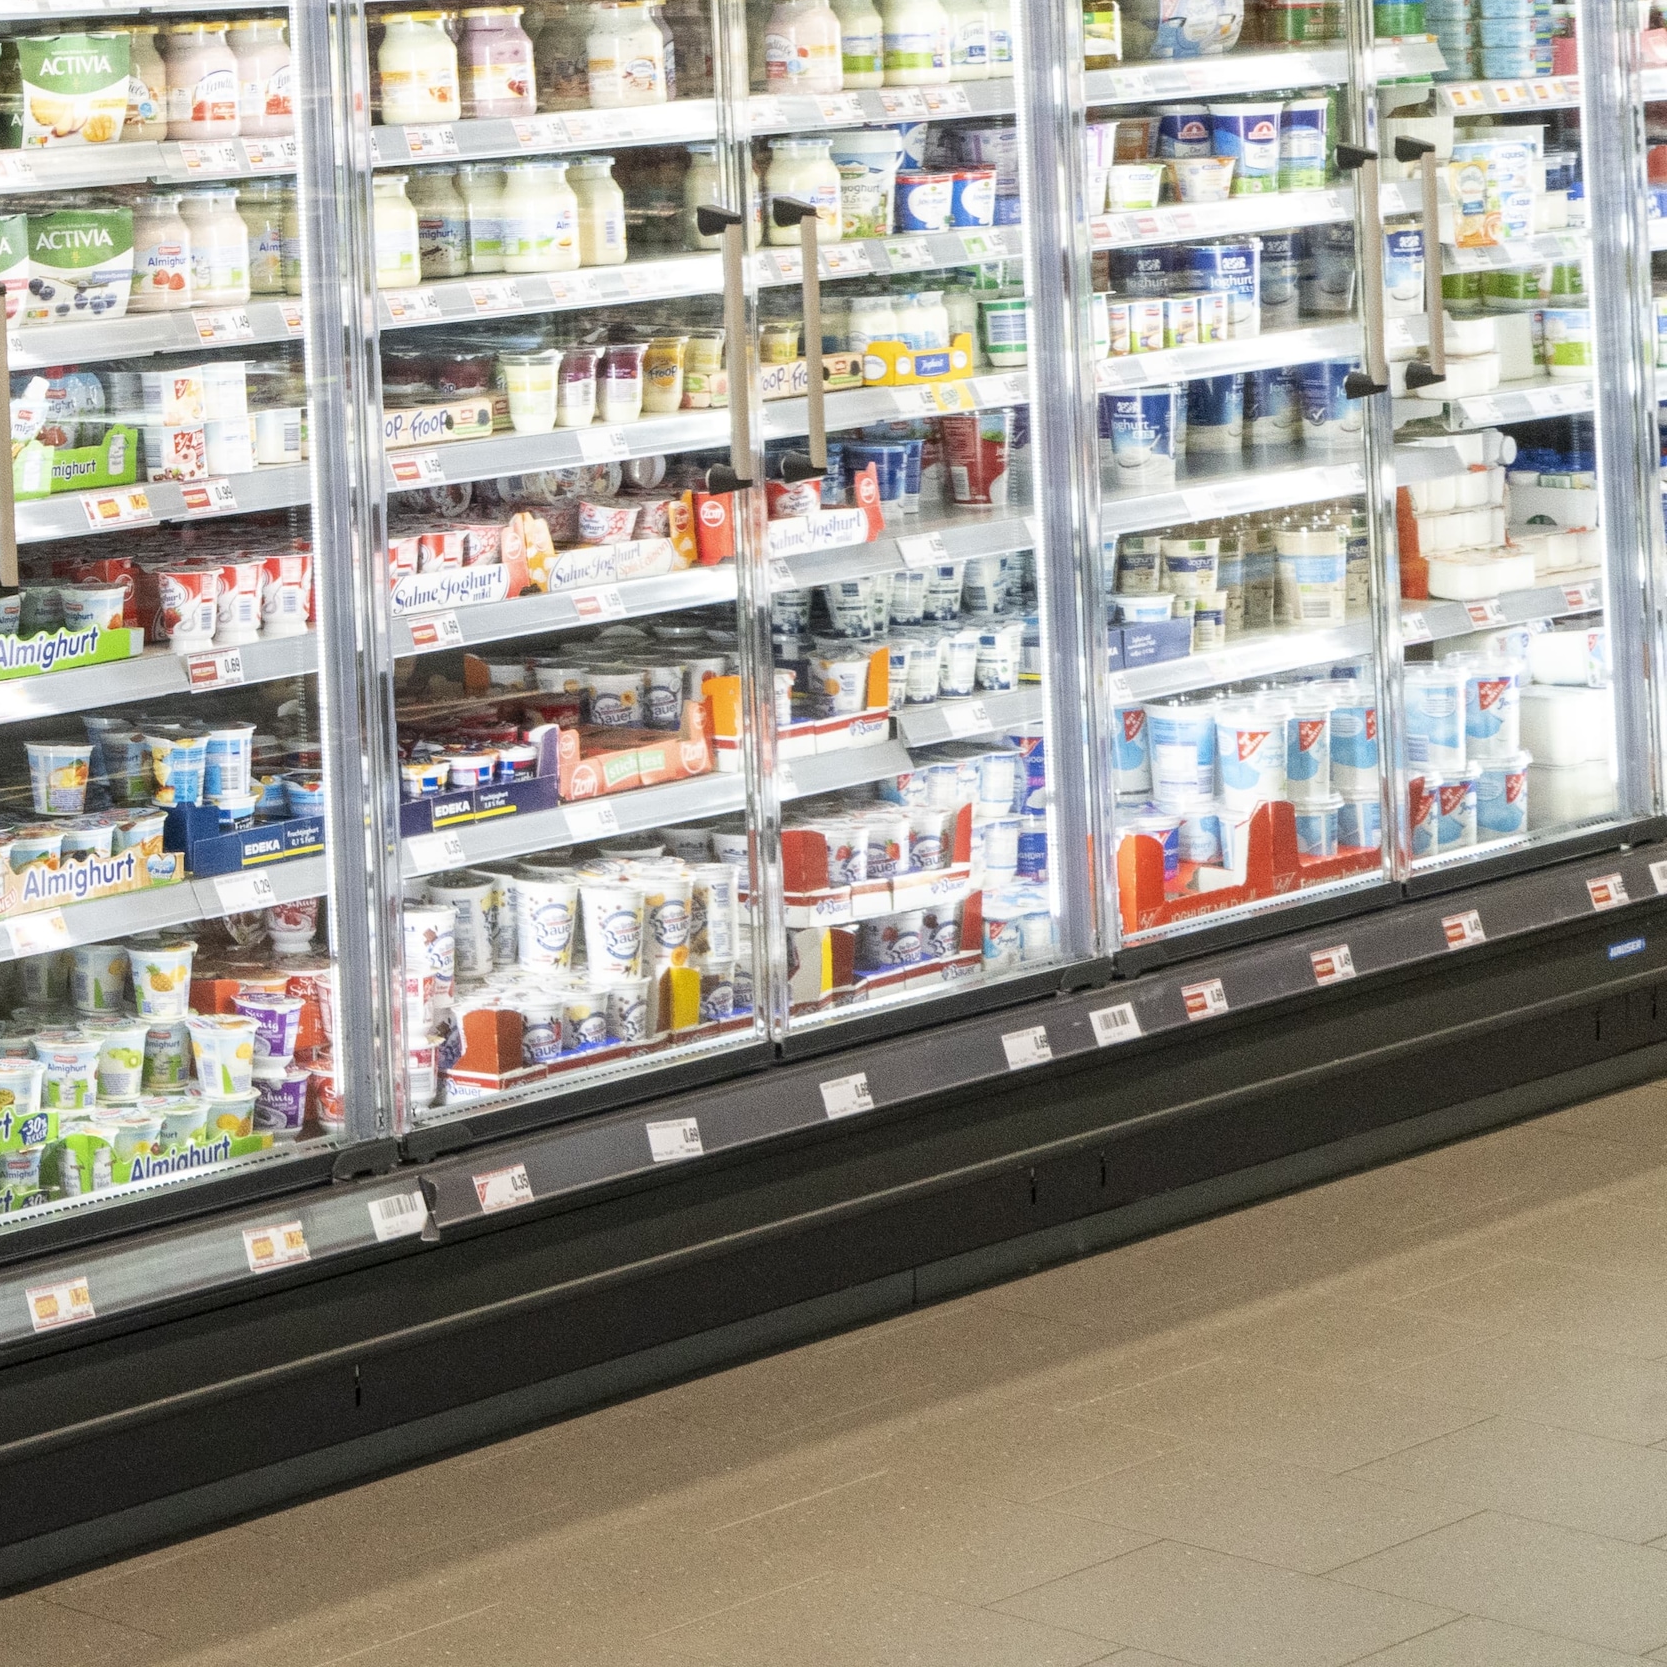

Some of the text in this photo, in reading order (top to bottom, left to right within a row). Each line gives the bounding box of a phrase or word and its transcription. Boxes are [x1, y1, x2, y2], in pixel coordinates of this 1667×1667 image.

[39, 55, 111, 78] ACTIVIA
[36, 226, 114, 253] ACTIVIA
[393, 568, 503, 613] Sahne Joghurt
[435, 800, 471, 818] EDEKA
[245, 838, 281, 857] EDEKA
[23, 854, 136, 903] Almighurt
[253, 878, 272, 897] 0.29
